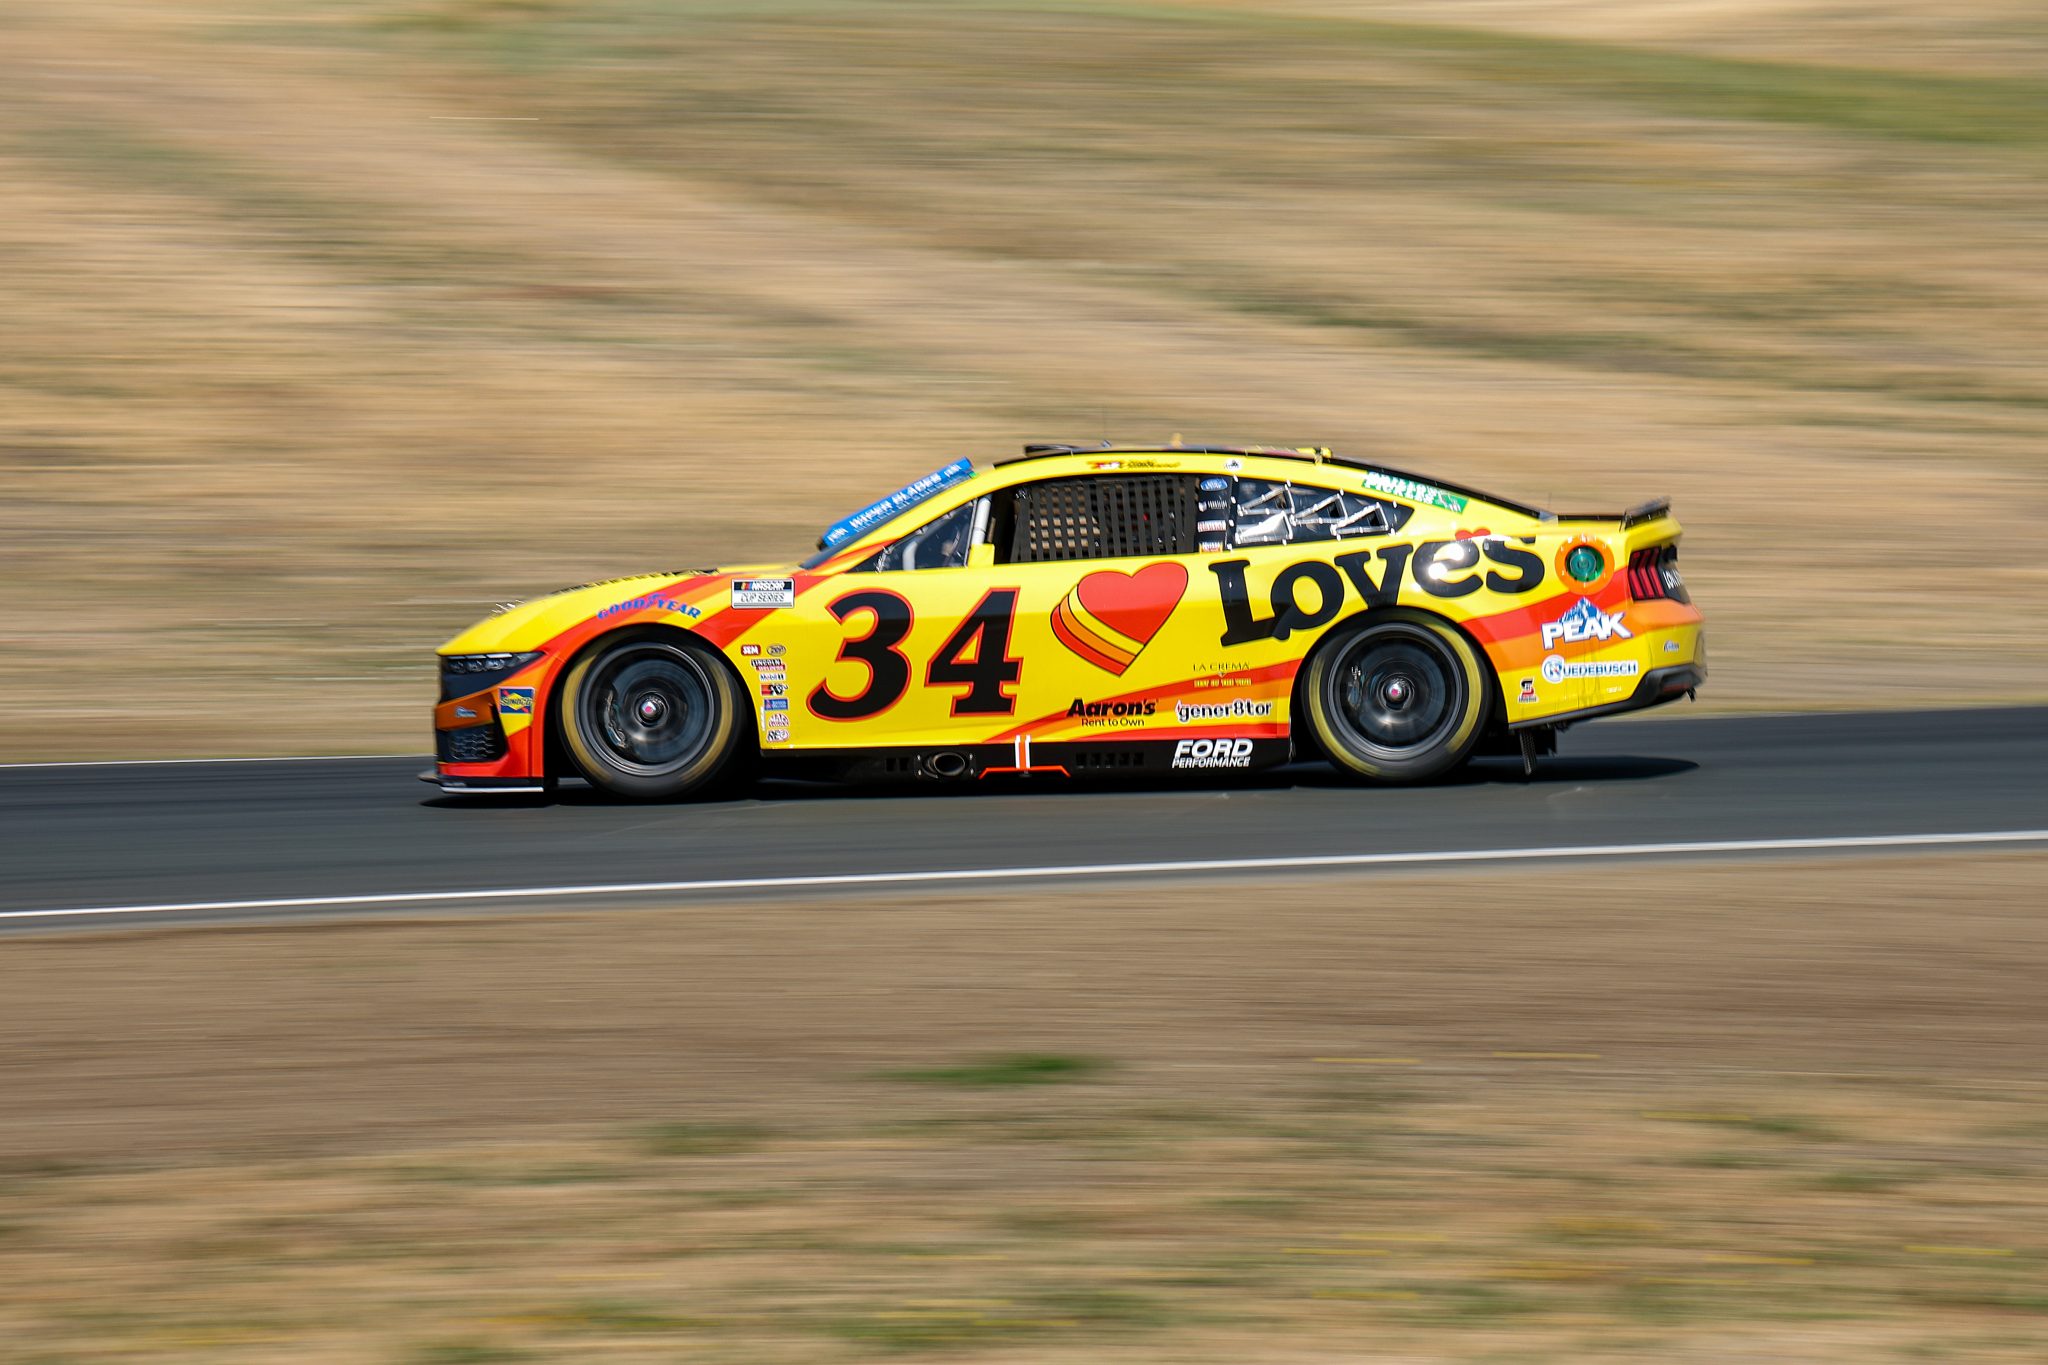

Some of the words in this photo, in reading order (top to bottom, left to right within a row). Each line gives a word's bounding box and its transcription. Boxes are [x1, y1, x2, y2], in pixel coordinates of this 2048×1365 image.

[752, 580, 785, 591] NASCAR
[597, 594, 701, 620] GOODYEAR
[741, 592, 757, 603] CUP
[758, 592, 785, 602] SERIES
[1541, 611, 1635, 650] PEAK
[806, 586, 1024, 723] 34
[1193, 662, 1207, 672] LA
[1209, 661, 1251, 672] CREMA
[1067, 698, 1156, 717] Aaron's
[1179, 700, 1271, 722] gener8tor
[1081, 717, 1105, 727] Rent
[1108, 718, 1118, 727] to
[1120, 718, 1145, 727] Own
[1174, 738, 1254, 759] FORD
[1172, 756, 1251, 769] PERFORMANCE
